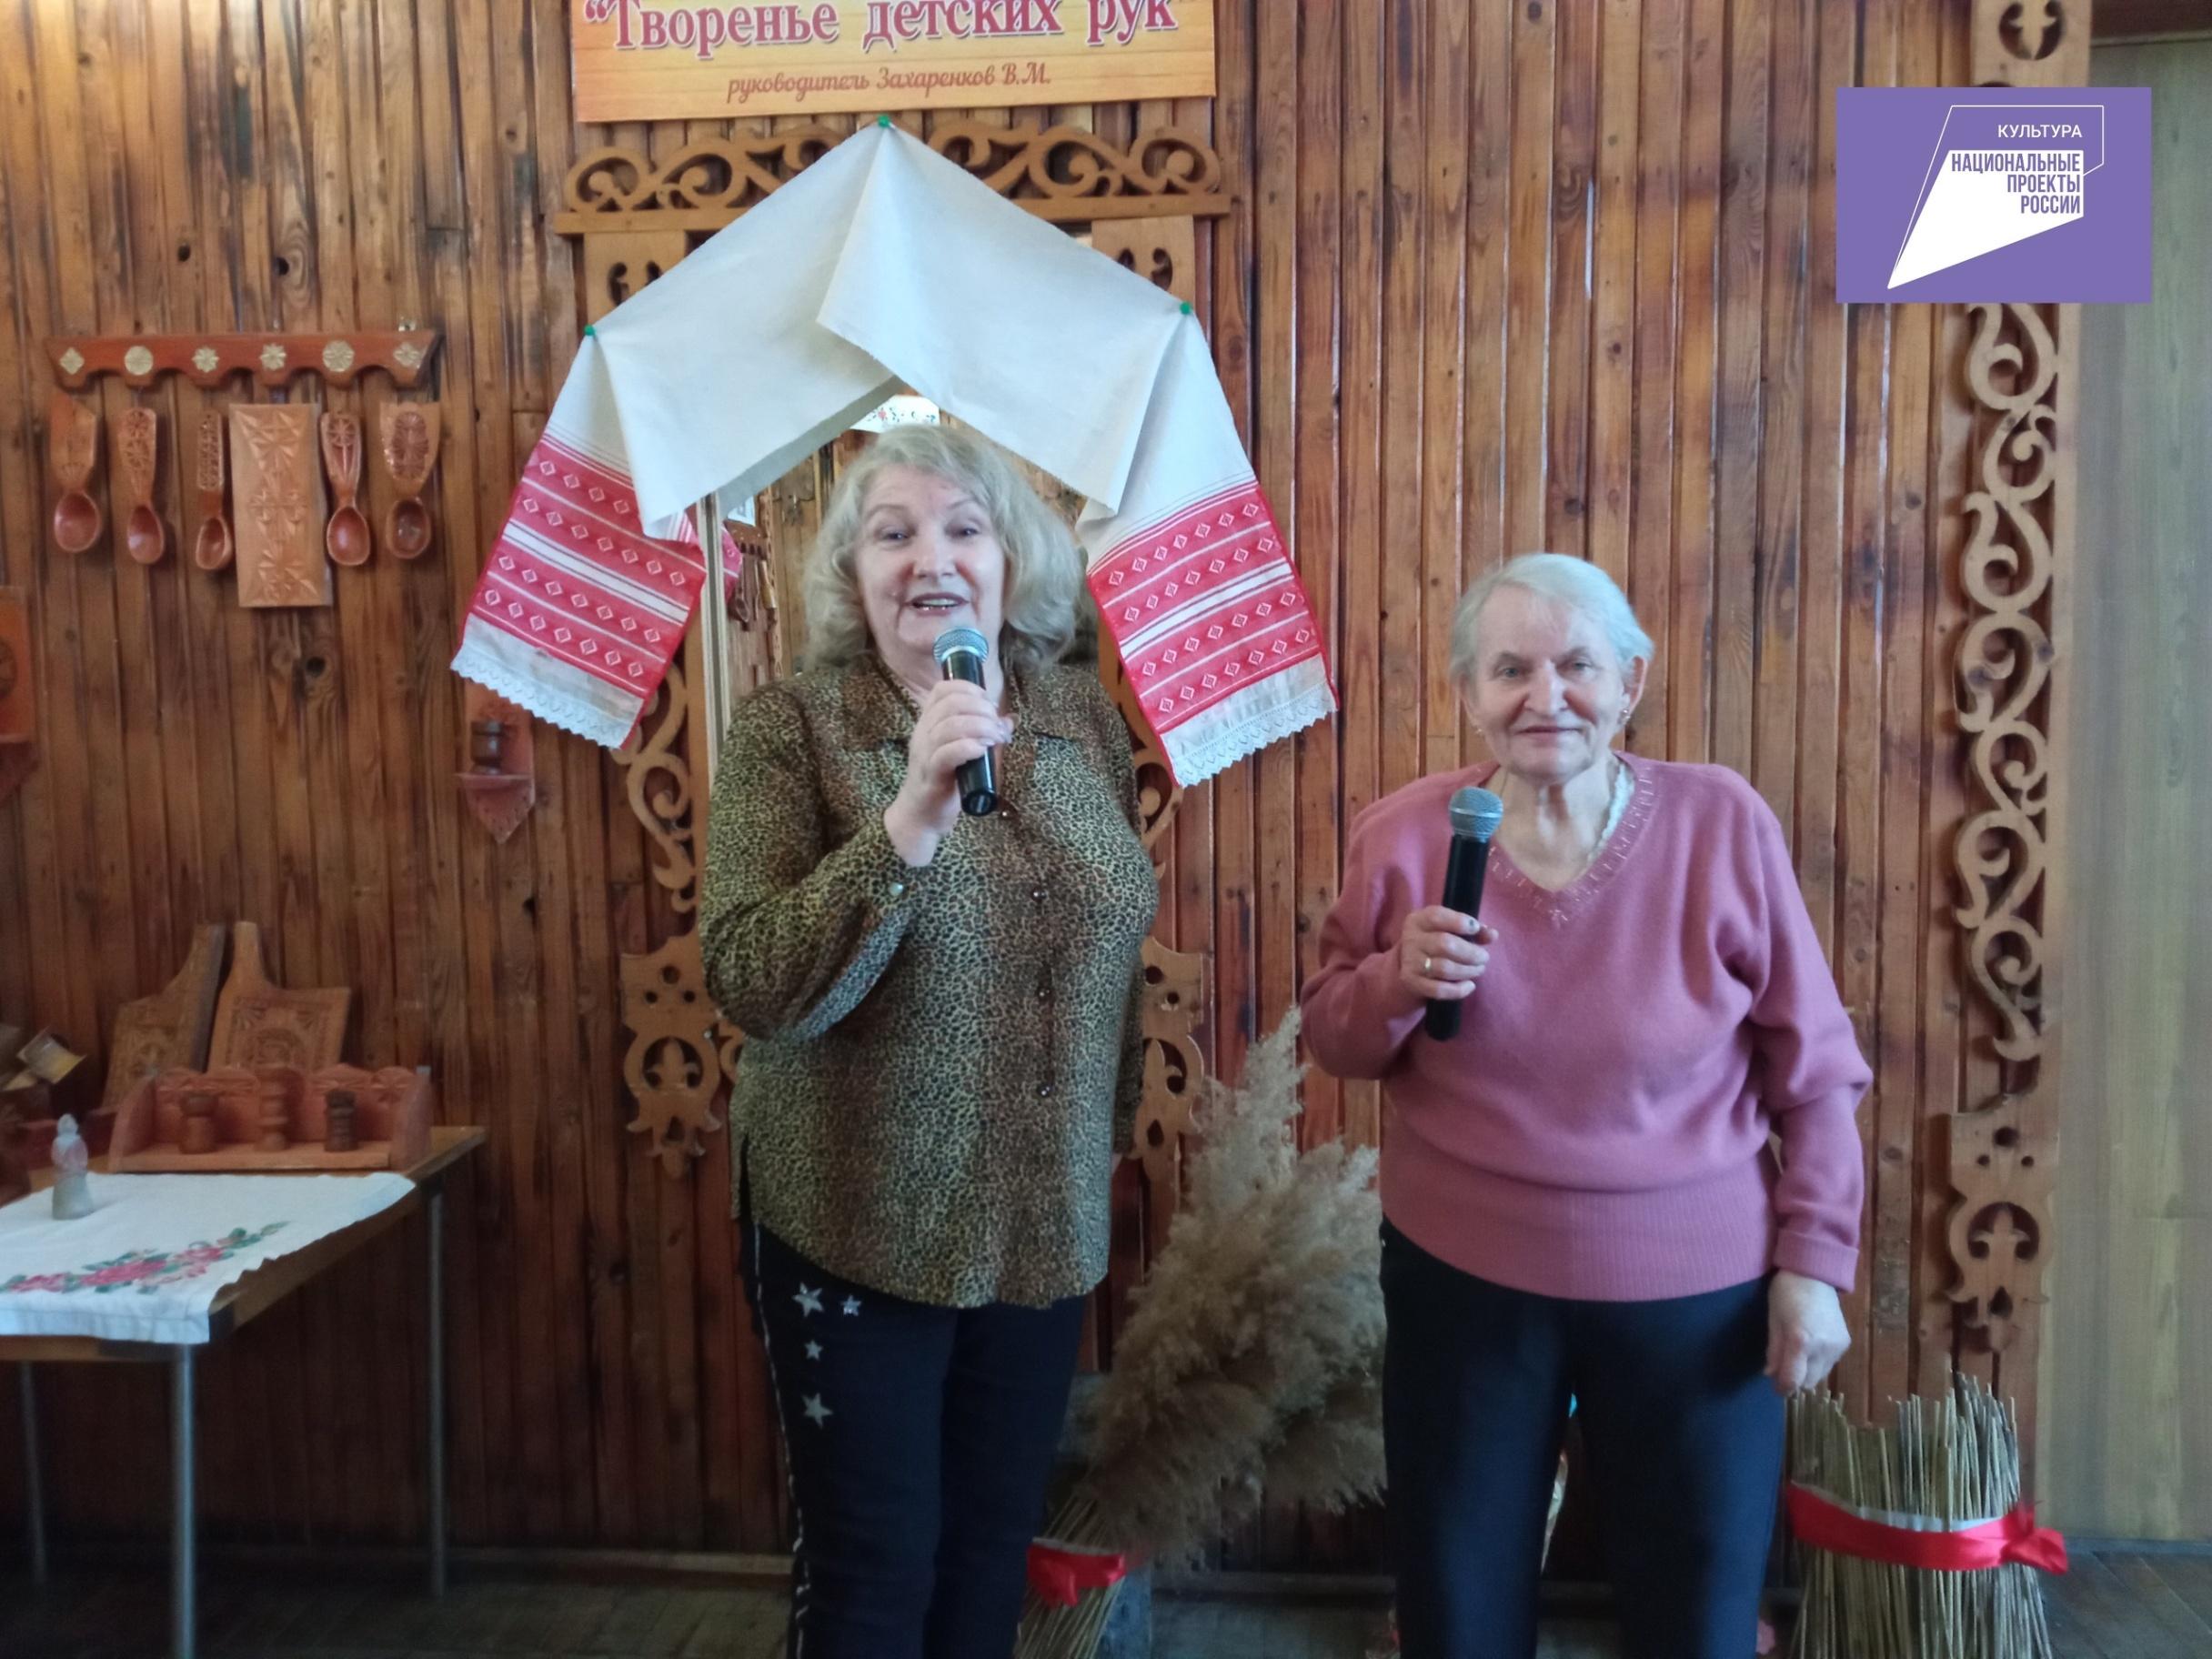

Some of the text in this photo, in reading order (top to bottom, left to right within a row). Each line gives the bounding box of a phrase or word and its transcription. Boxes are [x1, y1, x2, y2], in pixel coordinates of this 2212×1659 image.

[861, 0, 1062, 50] детских
[726, 61, 1051, 104] руководитель Захаренков В.М.
